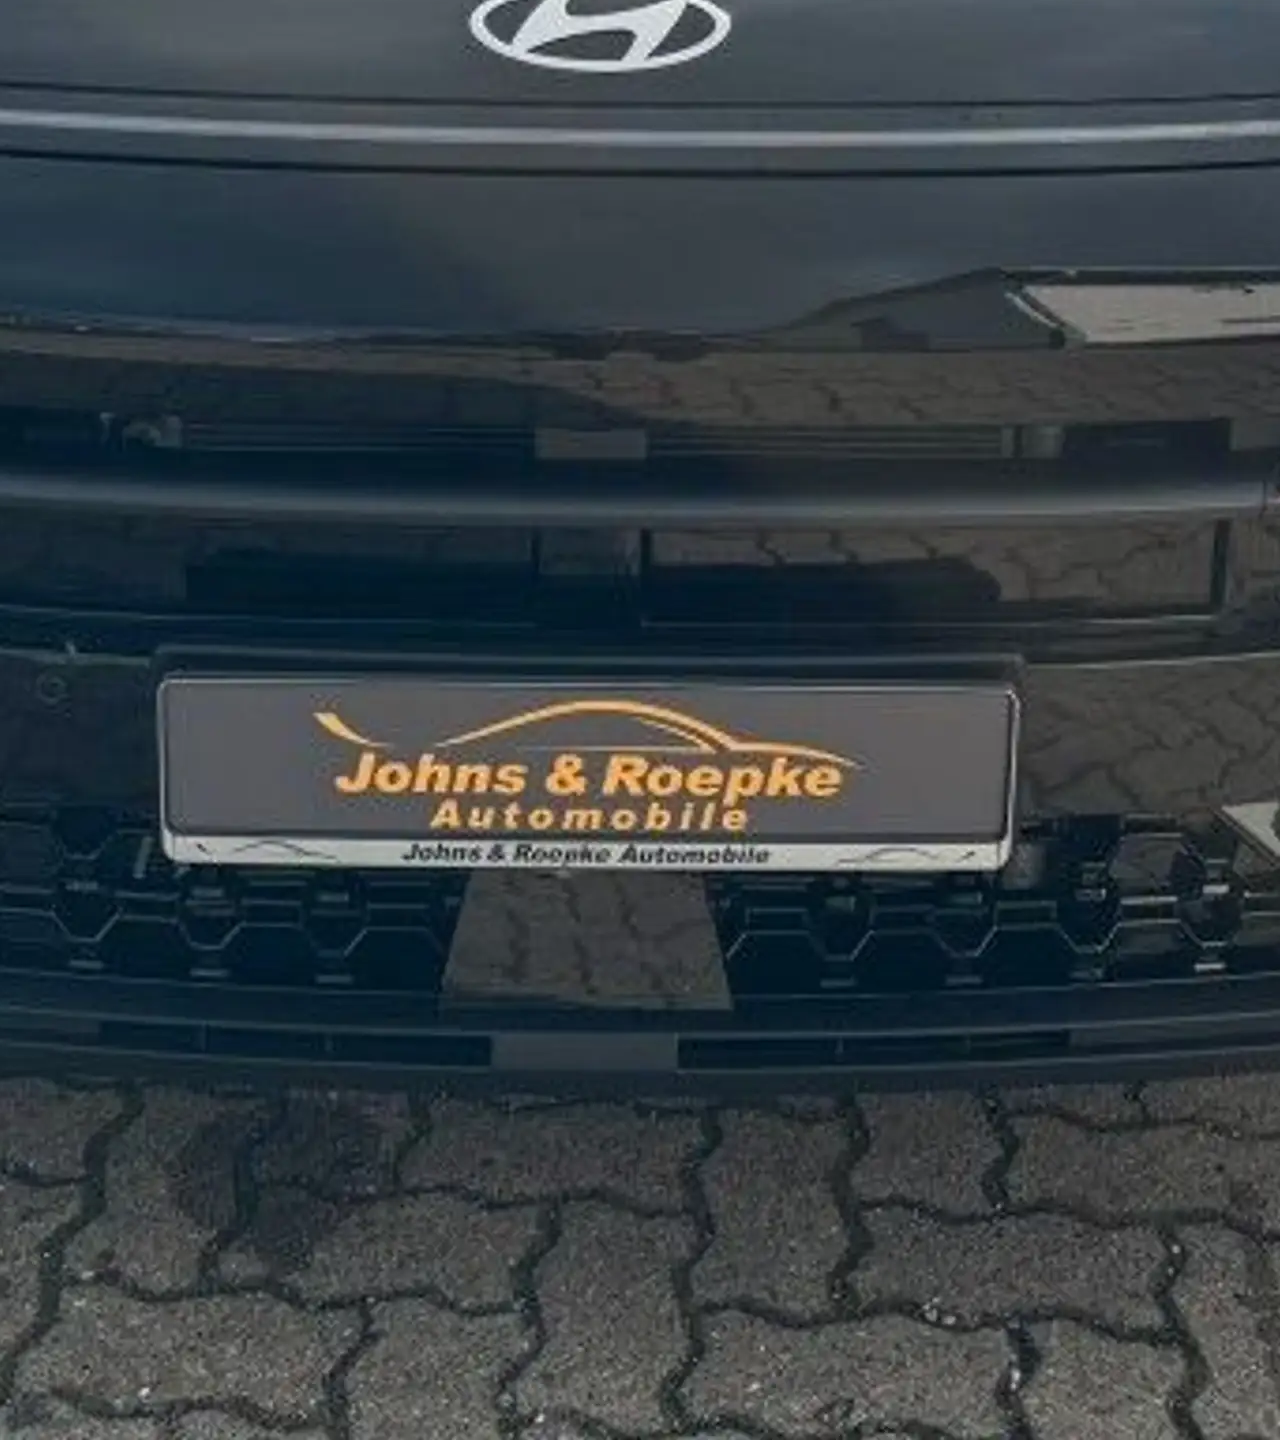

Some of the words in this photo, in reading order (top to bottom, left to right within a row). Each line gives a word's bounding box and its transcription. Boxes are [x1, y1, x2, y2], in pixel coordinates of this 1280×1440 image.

[334, 752, 528, 794] Johns
[546, 753, 588, 795] &
[603, 755, 842, 806] Roepke
[429, 798, 748, 831] Automobile
[400, 843, 483, 861] Johns
[487, 845, 506, 861] &
[514, 844, 611, 866] Roepke
[619, 845, 771, 864] Automobile
